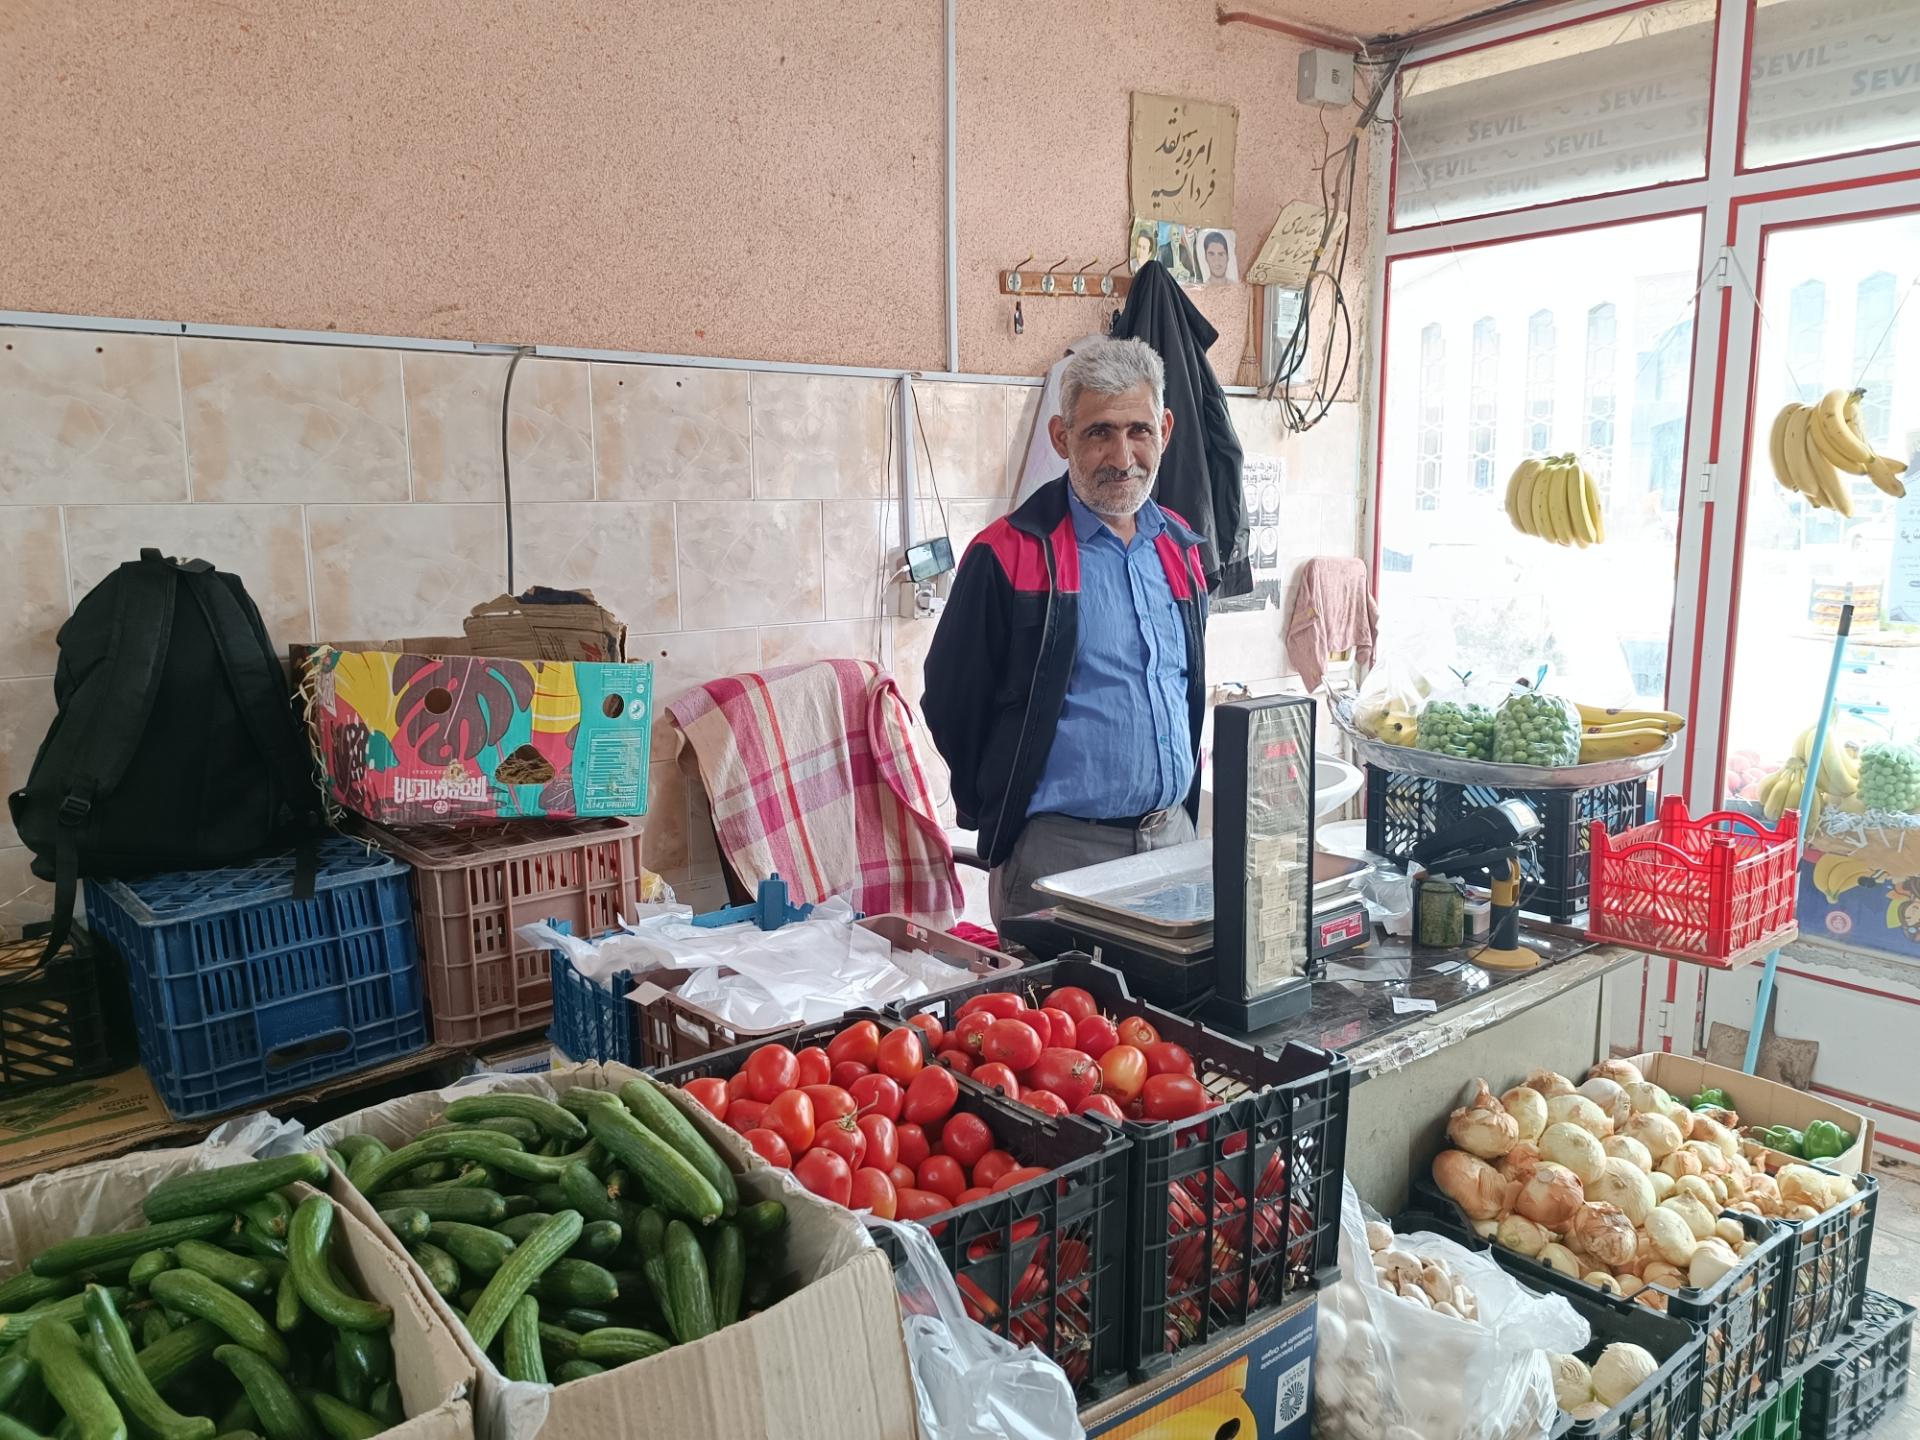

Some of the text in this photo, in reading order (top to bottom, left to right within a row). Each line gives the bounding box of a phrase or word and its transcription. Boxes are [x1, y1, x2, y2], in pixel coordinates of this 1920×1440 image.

[1751, 46, 1831, 80] SEVIL
[1598, 83, 1667, 113] SEVIL
[1467, 114, 1528, 142] SEVIL
[1768, 113, 1848, 143] SEVIL
[1543, 129, 1608, 158] SEVIL
[1421, 157, 1477, 184] SEVIL
[1614, 148, 1681, 175] SEVIL
[1189, 168, 1217, 210] فردا
